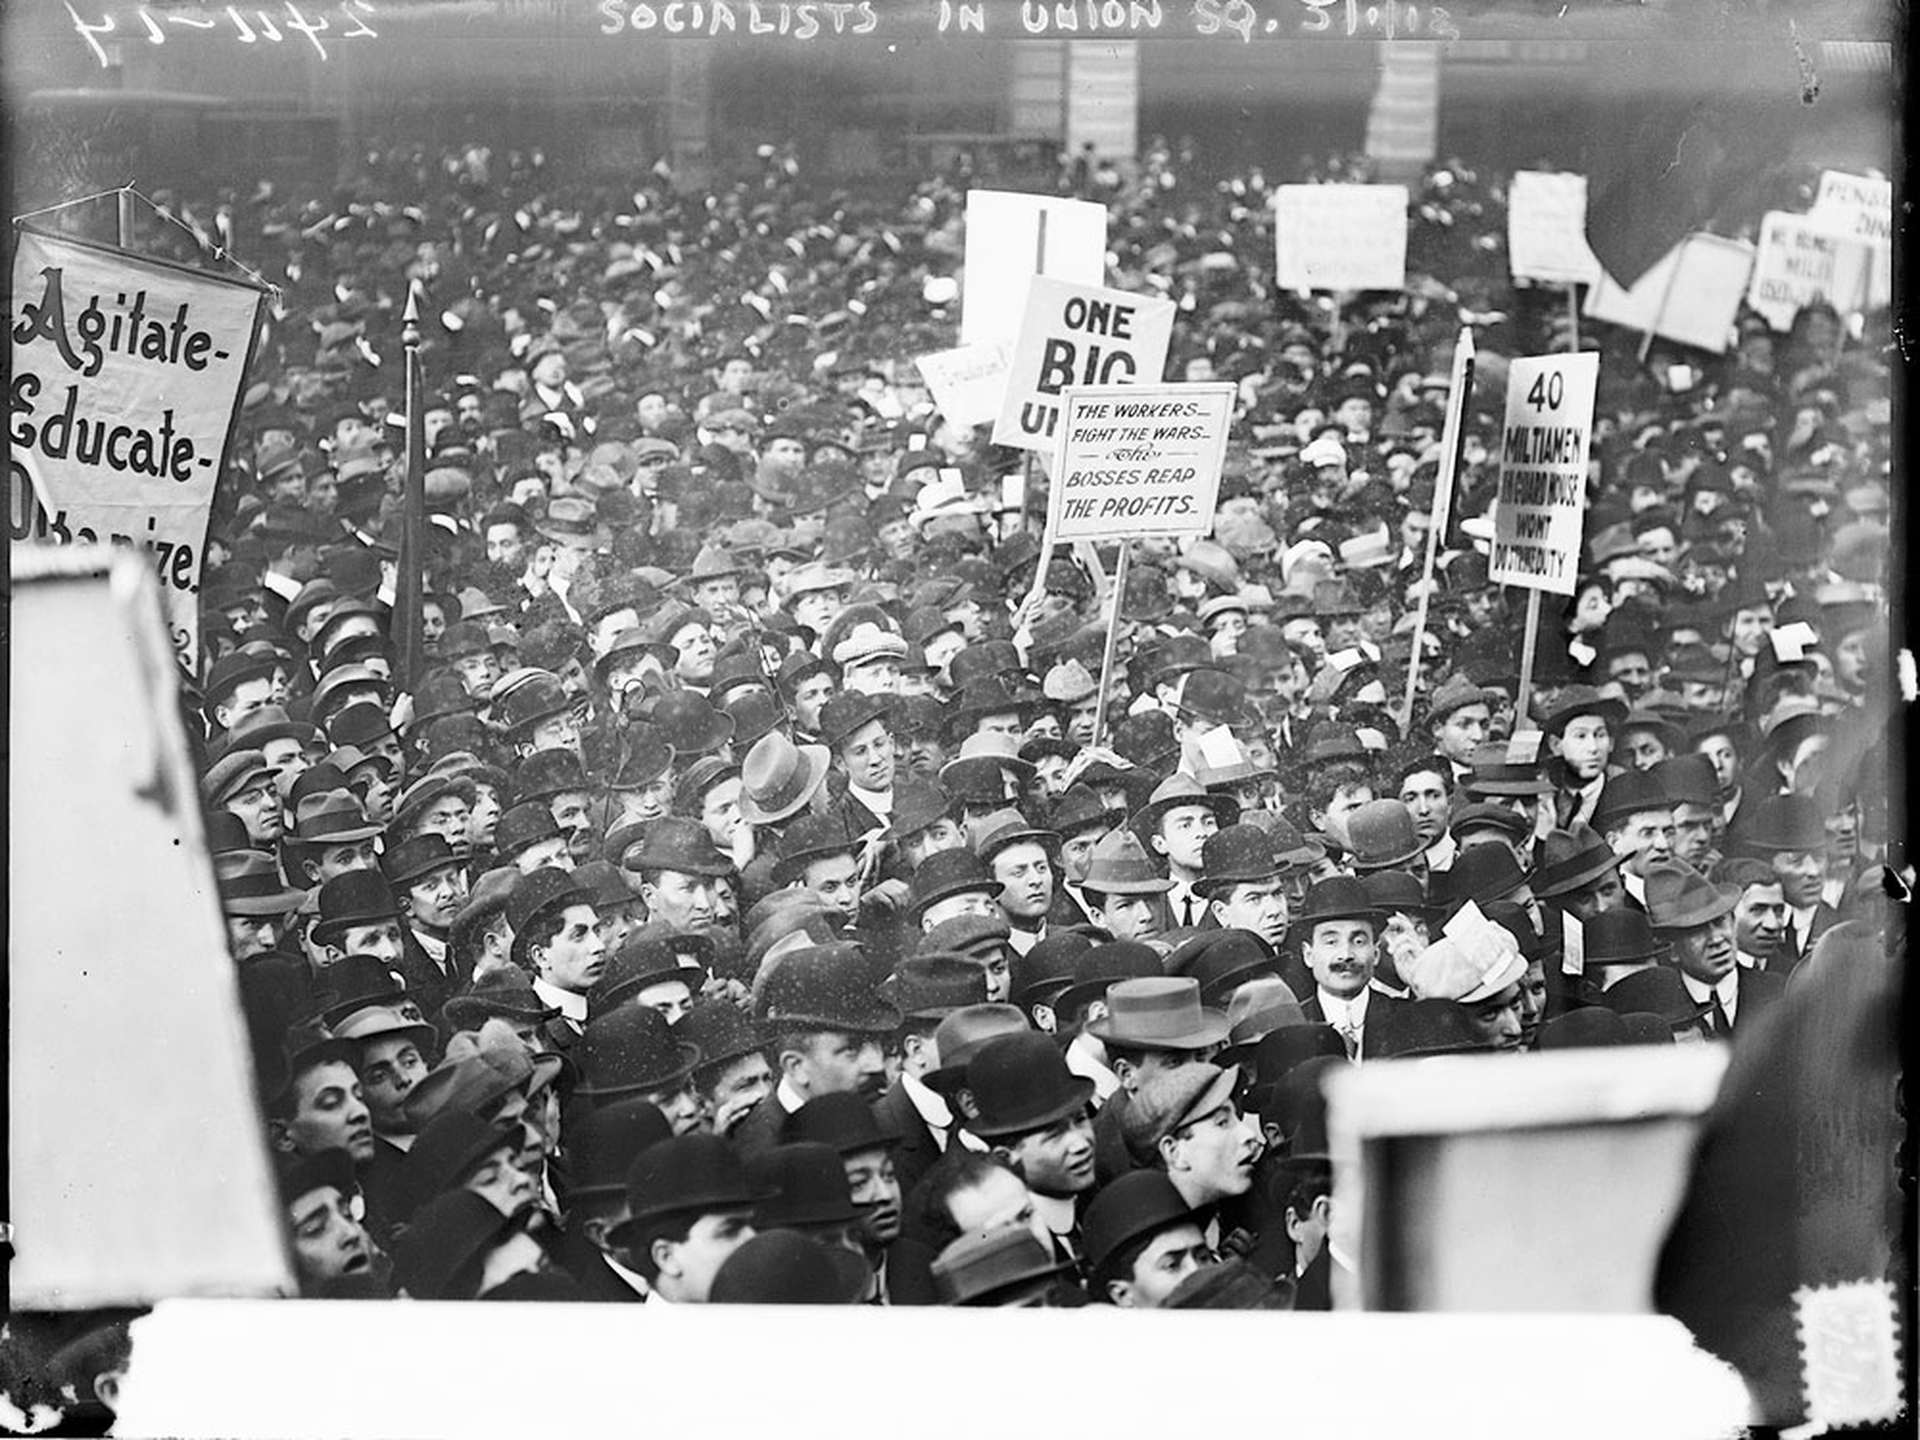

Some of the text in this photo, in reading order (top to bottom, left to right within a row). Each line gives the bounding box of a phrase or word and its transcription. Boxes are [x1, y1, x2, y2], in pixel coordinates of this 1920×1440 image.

[13, 267, 229, 376] Agitate-
[1064, 297, 1136, 340] ONE
[1036, 338, 1136, 395] BIG
[1077, 404, 1110, 419] THE
[1527, 371, 1564, 413] 40
[9, 373, 212, 481] Educate-
[1071, 428, 1118, 443] FIGHT
[1119, 427, 1149, 441] THE
[1066, 468, 1195, 488] BOSSES REAP
[1064, 498, 1098, 519] THE
